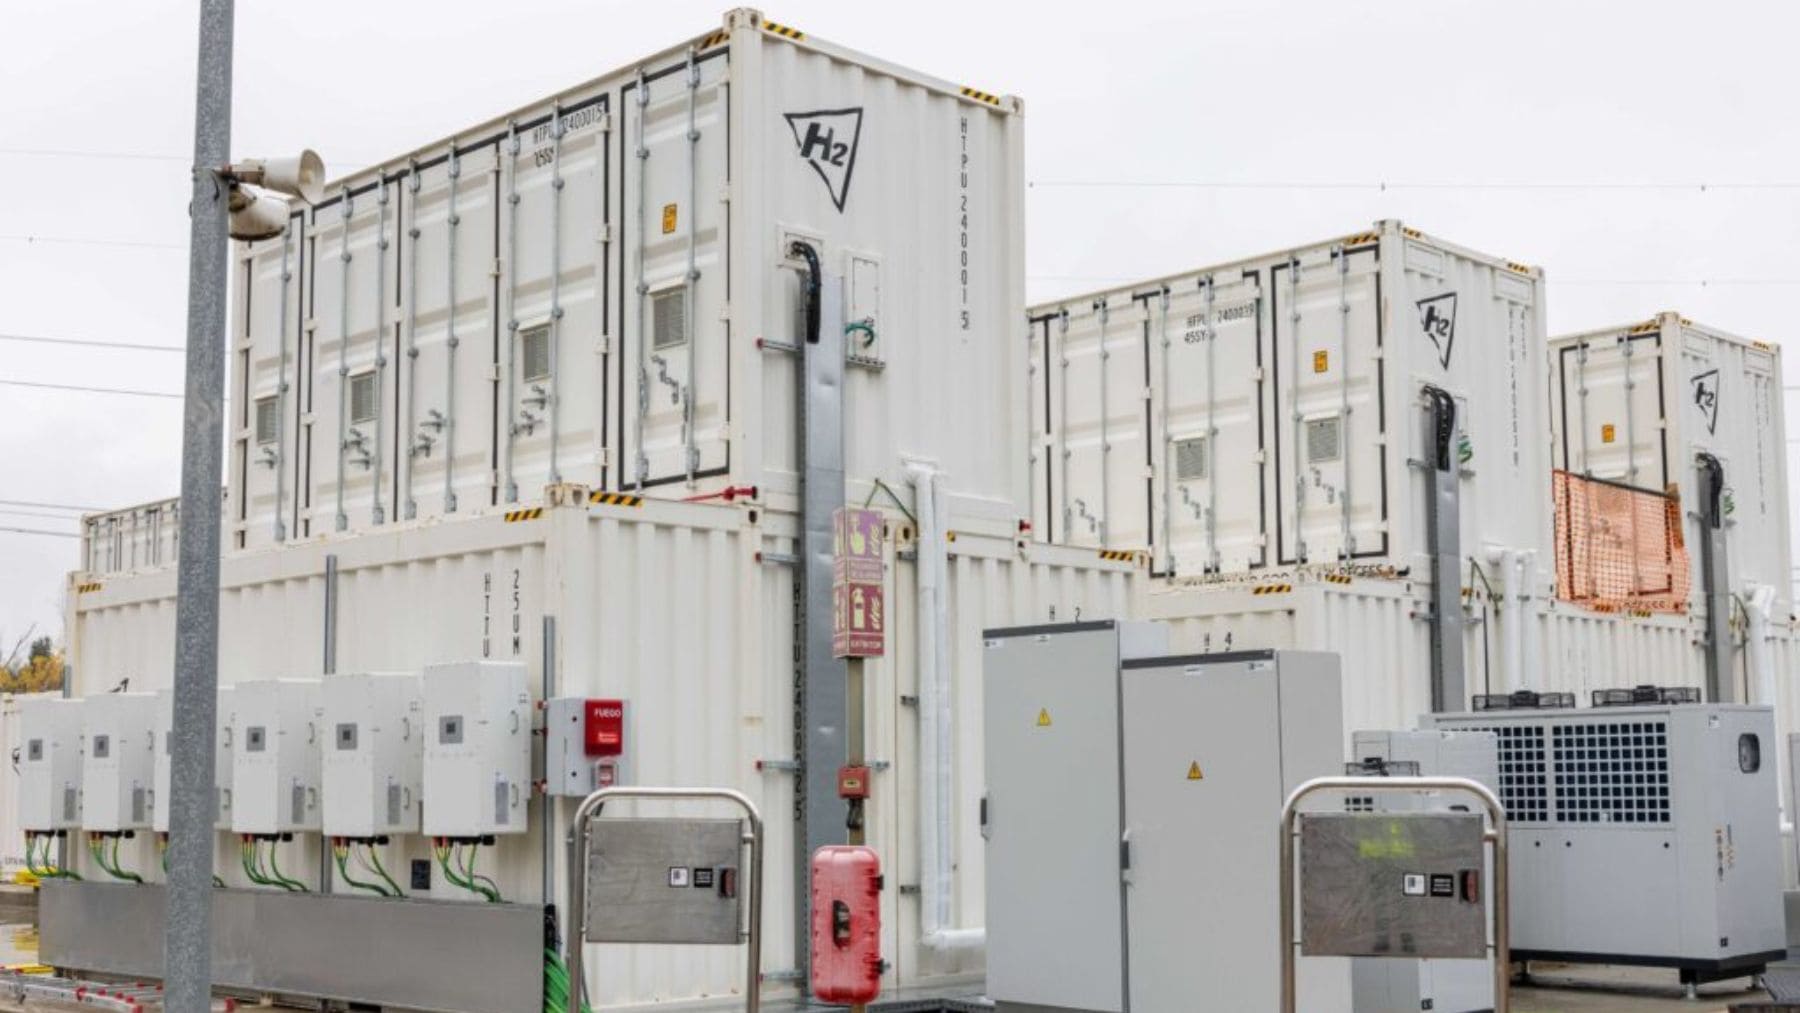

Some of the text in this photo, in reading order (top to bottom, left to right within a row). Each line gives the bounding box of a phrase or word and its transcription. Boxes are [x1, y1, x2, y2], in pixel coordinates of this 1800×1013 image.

[800, 121, 849, 167] H2
[1422, 305, 1450, 337] H2
[593, 708, 622, 719] FUEGO
